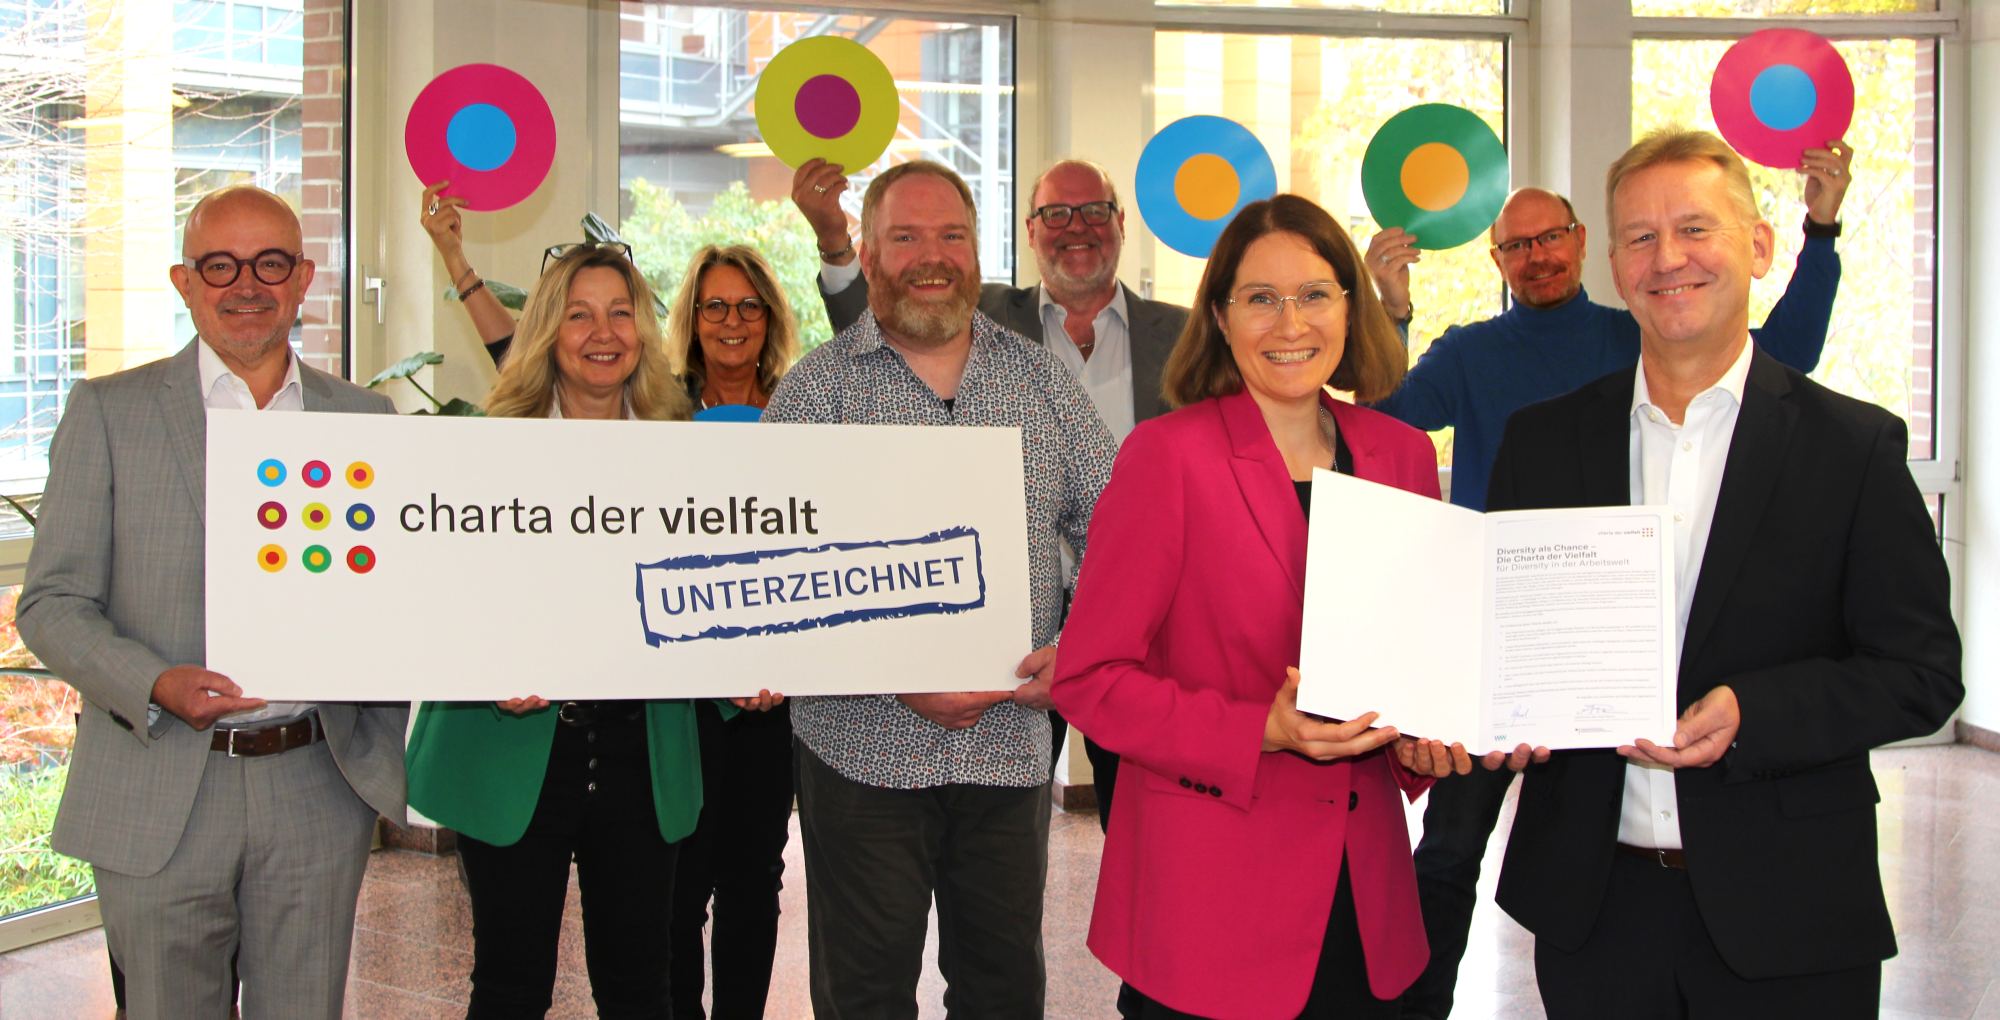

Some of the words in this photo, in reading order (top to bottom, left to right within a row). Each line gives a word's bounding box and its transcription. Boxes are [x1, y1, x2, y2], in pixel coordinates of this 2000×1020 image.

[400, 493, 552, 534] charta
[570, 495, 645, 535] der
[658, 496, 819, 536] vielfalt
[1497, 546, 1536, 556] Diversity
[1538, 545, 1552, 553] als
[1553, 544, 1589, 552] Chance
[1496, 555, 1512, 564] Die
[1513, 554, 1545, 562] Charta
[1564, 551, 1597, 559] Vielfalt
[1496, 564, 1509, 572] für
[1511, 562, 1549, 571] Diversity
[1562, 560, 1577, 568] der
[1579, 558, 1629, 568] Arbeitswelt
[661, 556, 964, 616] UNTERZEICHNET
